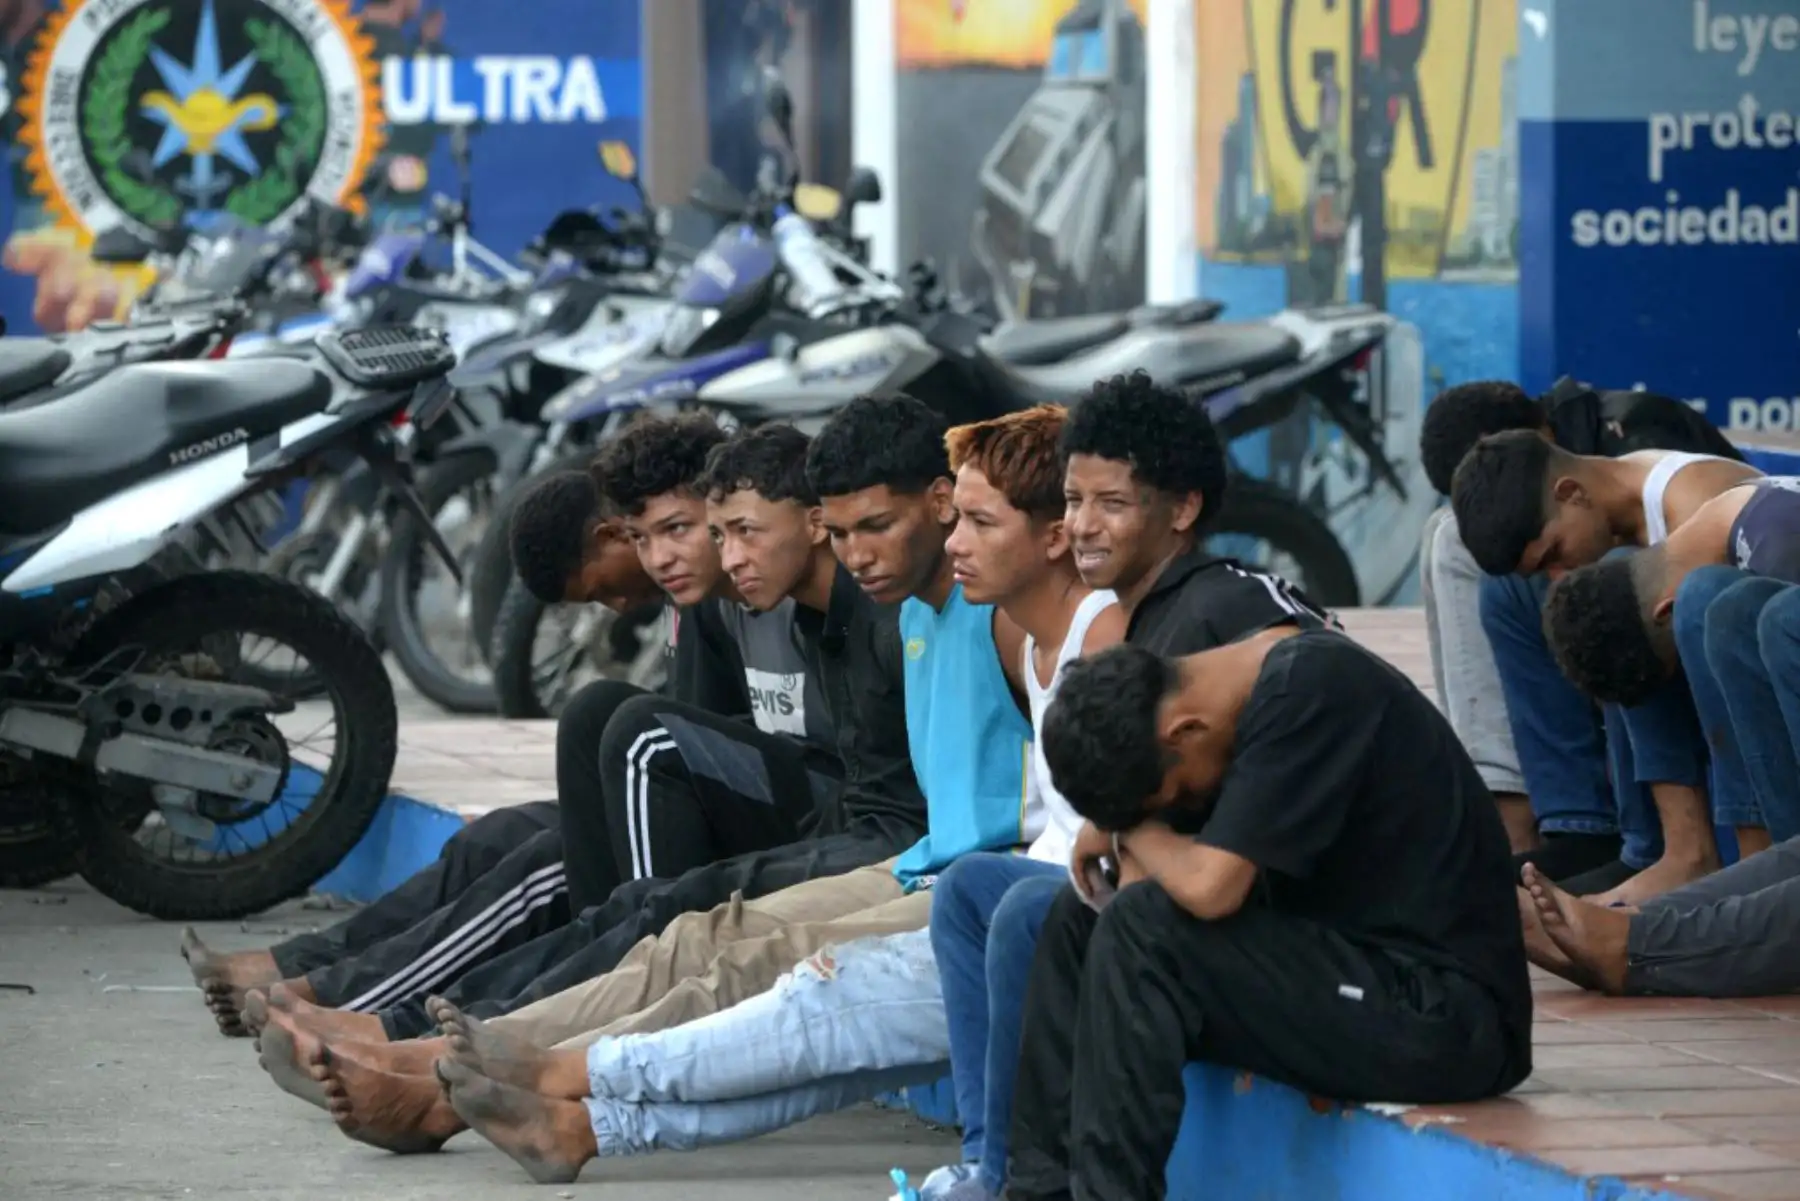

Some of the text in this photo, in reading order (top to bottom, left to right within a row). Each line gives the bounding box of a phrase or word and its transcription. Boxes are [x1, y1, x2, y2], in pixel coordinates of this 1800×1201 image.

[1692, 0, 1799, 76] leye
[383, 55, 607, 124] ULTRA
[1648, 94, 1800, 182] prote
[1571, 188, 1799, 247] sociedad
[169, 427, 250, 465] HONDA
